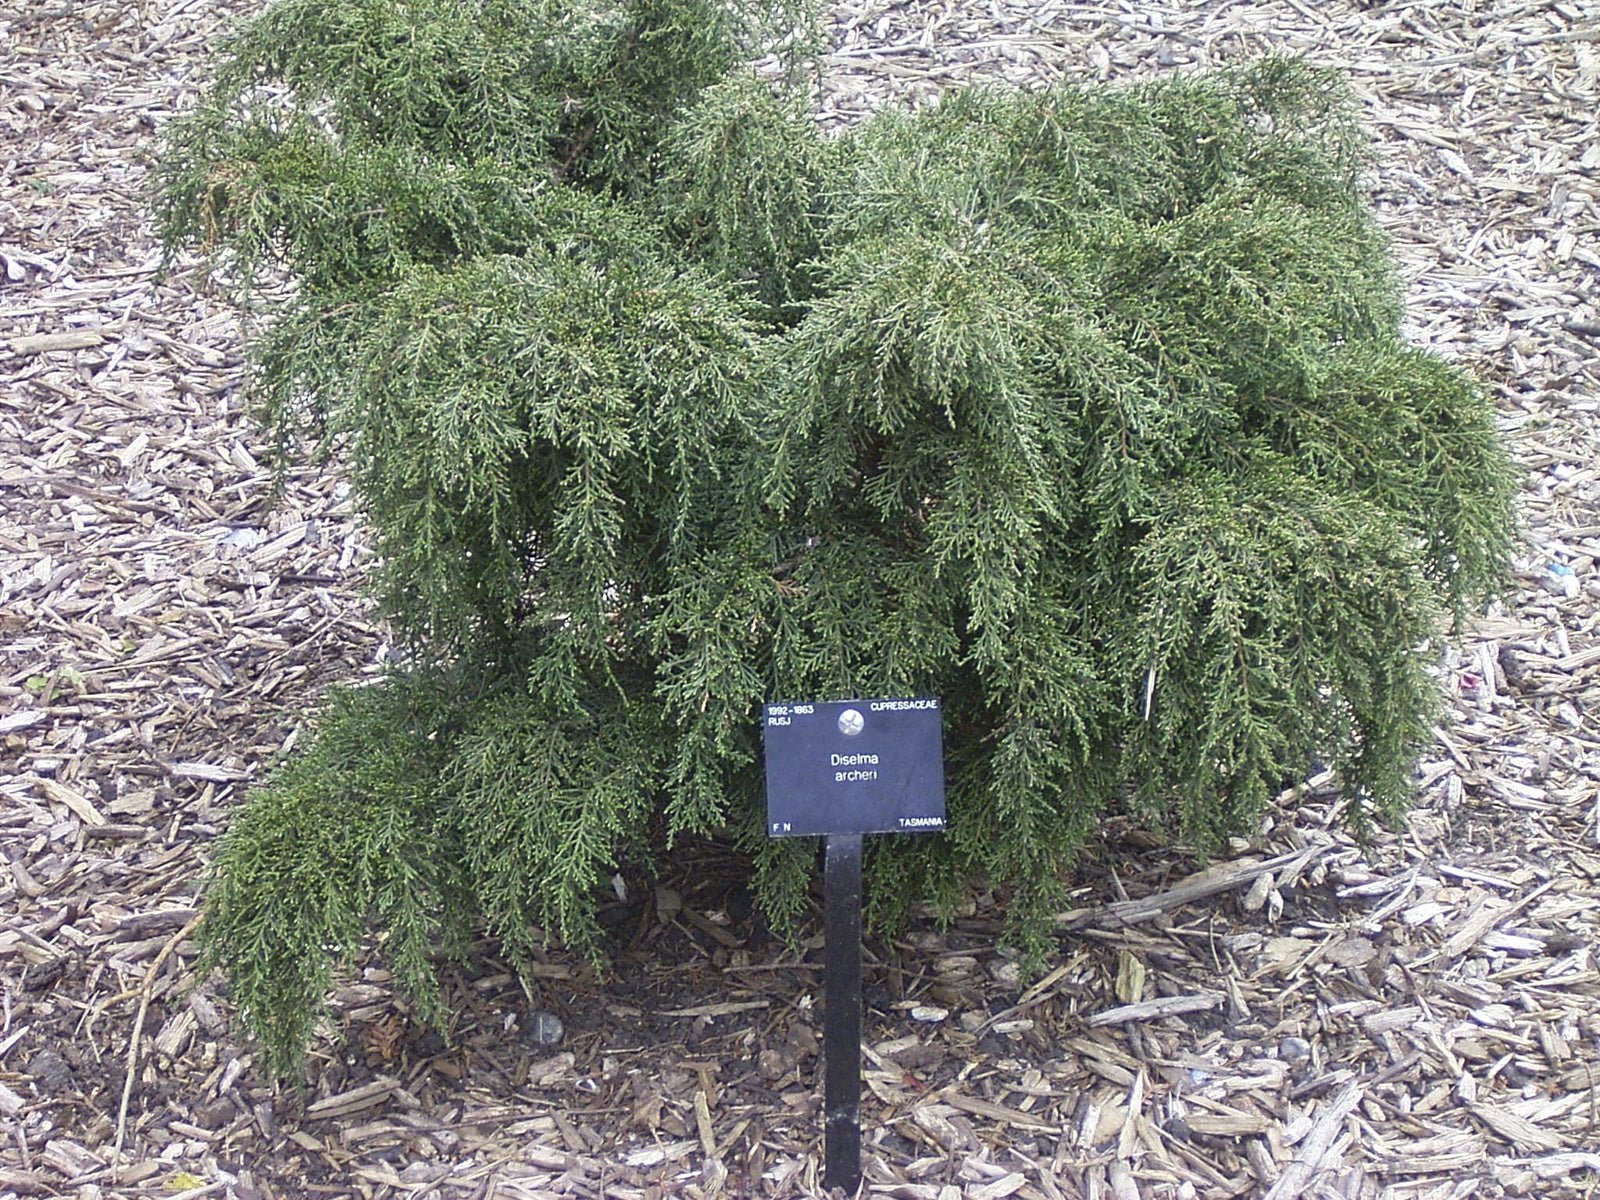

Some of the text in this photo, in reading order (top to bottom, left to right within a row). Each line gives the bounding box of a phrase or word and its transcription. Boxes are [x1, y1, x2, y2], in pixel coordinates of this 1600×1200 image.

[768, 705, 814, 715] 1992-1863
[870, 700, 938, 711] CUPRESSACEAE
[768, 717, 791, 726] RUSJ
[831, 753, 879, 766] Diselma
[835, 769, 877, 781] archeri
[773, 822, 791, 832] F N
[899, 817, 943, 827] TASMANIA
